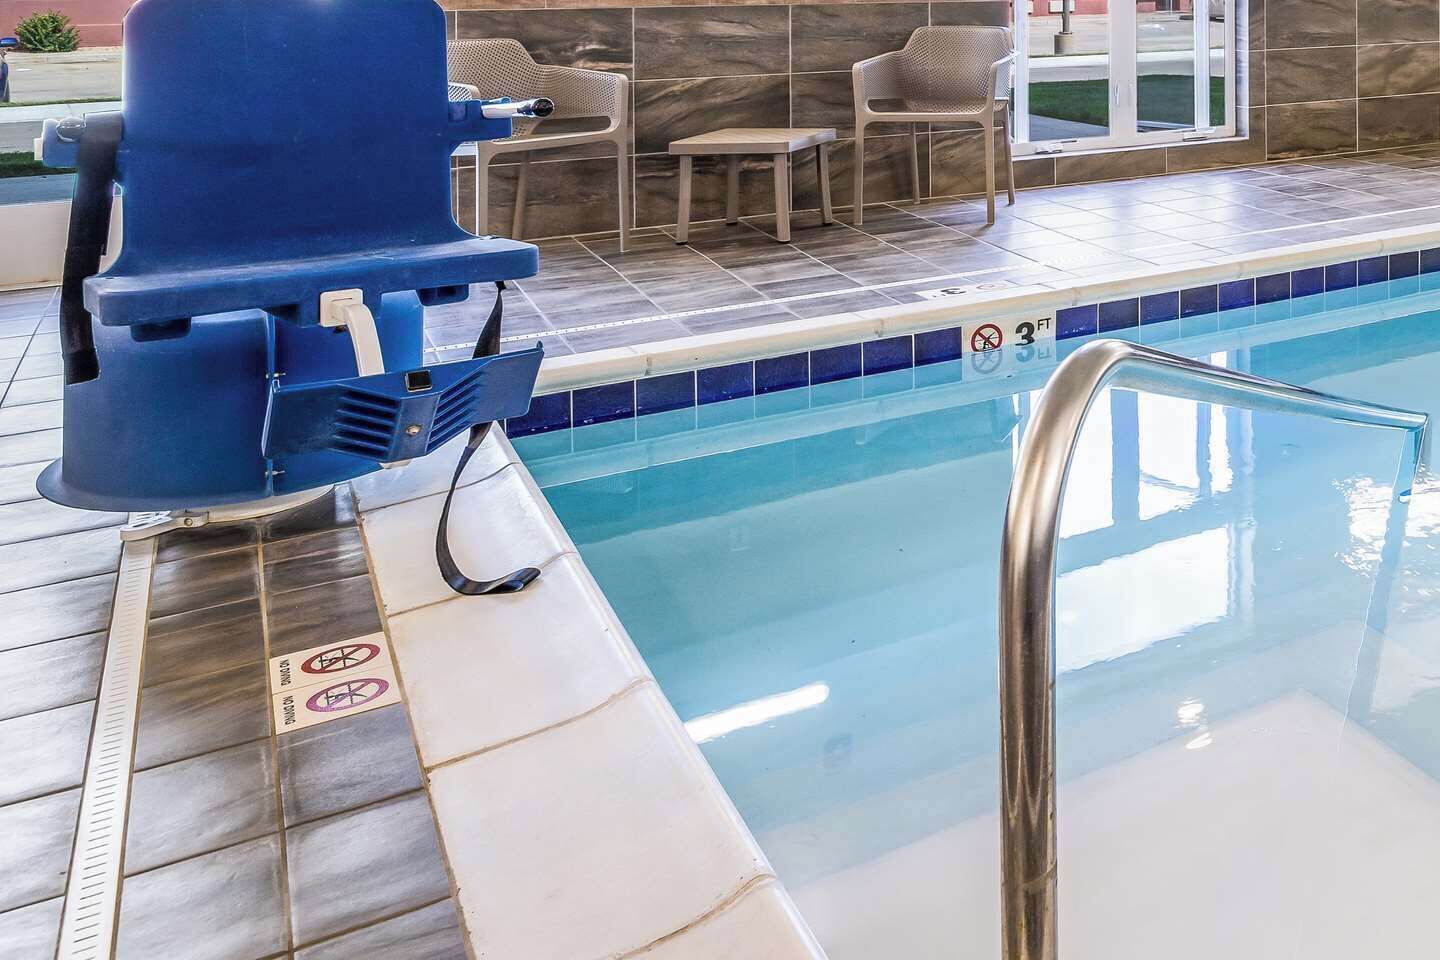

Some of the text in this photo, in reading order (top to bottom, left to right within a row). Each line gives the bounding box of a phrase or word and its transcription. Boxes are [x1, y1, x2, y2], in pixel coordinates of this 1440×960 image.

[1015, 317, 1052, 346] 3 FT
[279, 659, 292, 686] NO DIVING
[282, 695, 296, 725] NO DIVING
